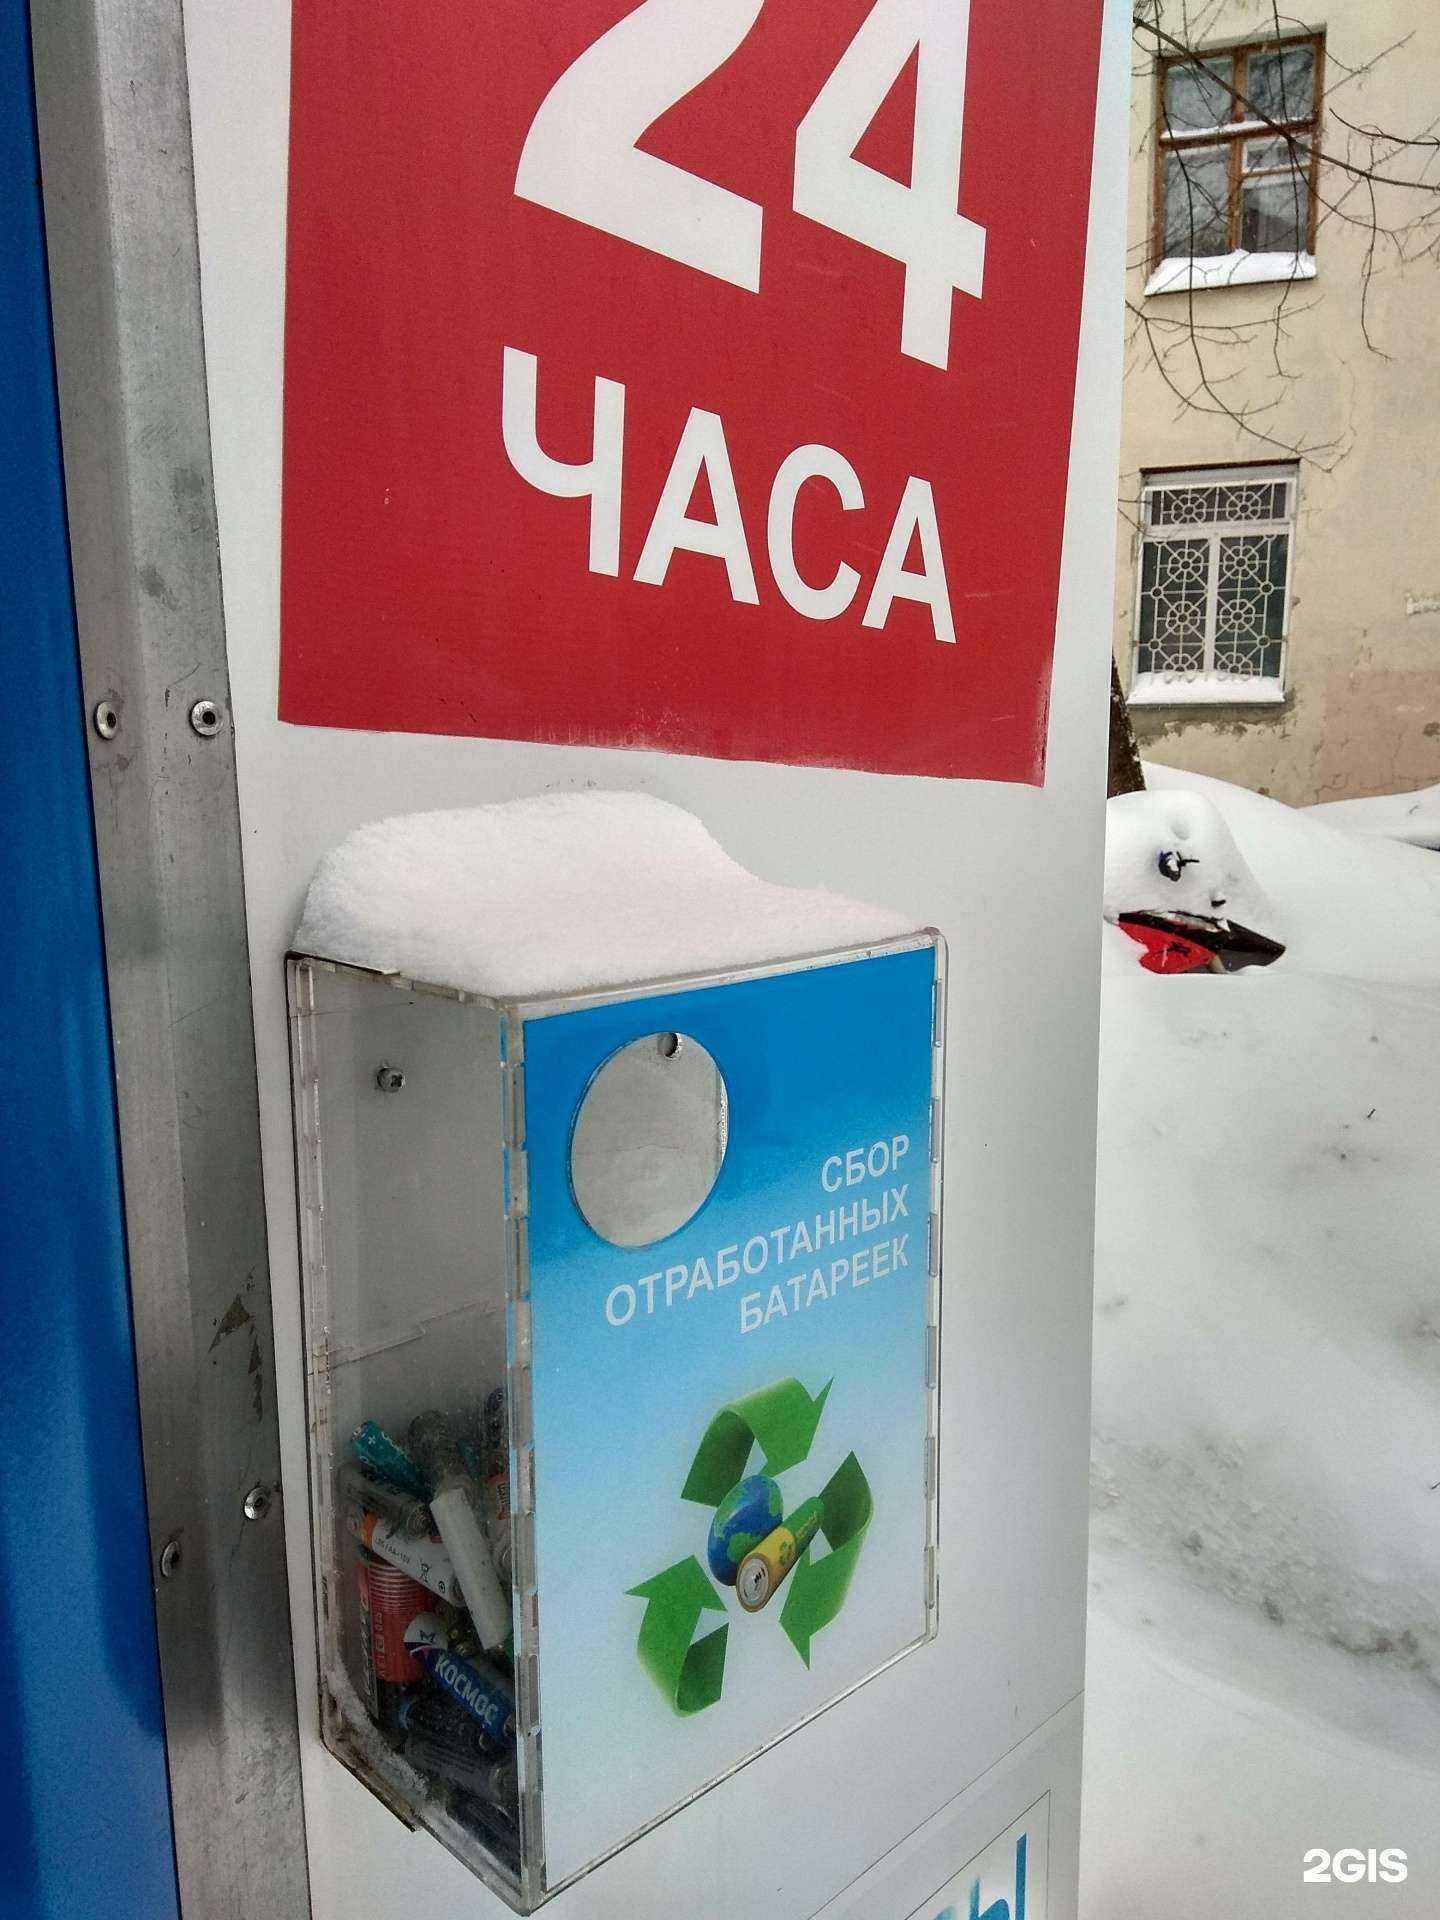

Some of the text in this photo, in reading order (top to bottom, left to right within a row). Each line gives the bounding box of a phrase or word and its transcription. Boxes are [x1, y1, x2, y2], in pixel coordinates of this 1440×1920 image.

[502, 345, 957, 643] ЧАСА
[821, 1135, 910, 1193] СБОР
[605, 1184, 909, 1326] ОТРАБОТАННЫХ
[739, 1234, 909, 1334] БАТАРЕЕК
[434, 1652, 499, 1727] КОСМОС
